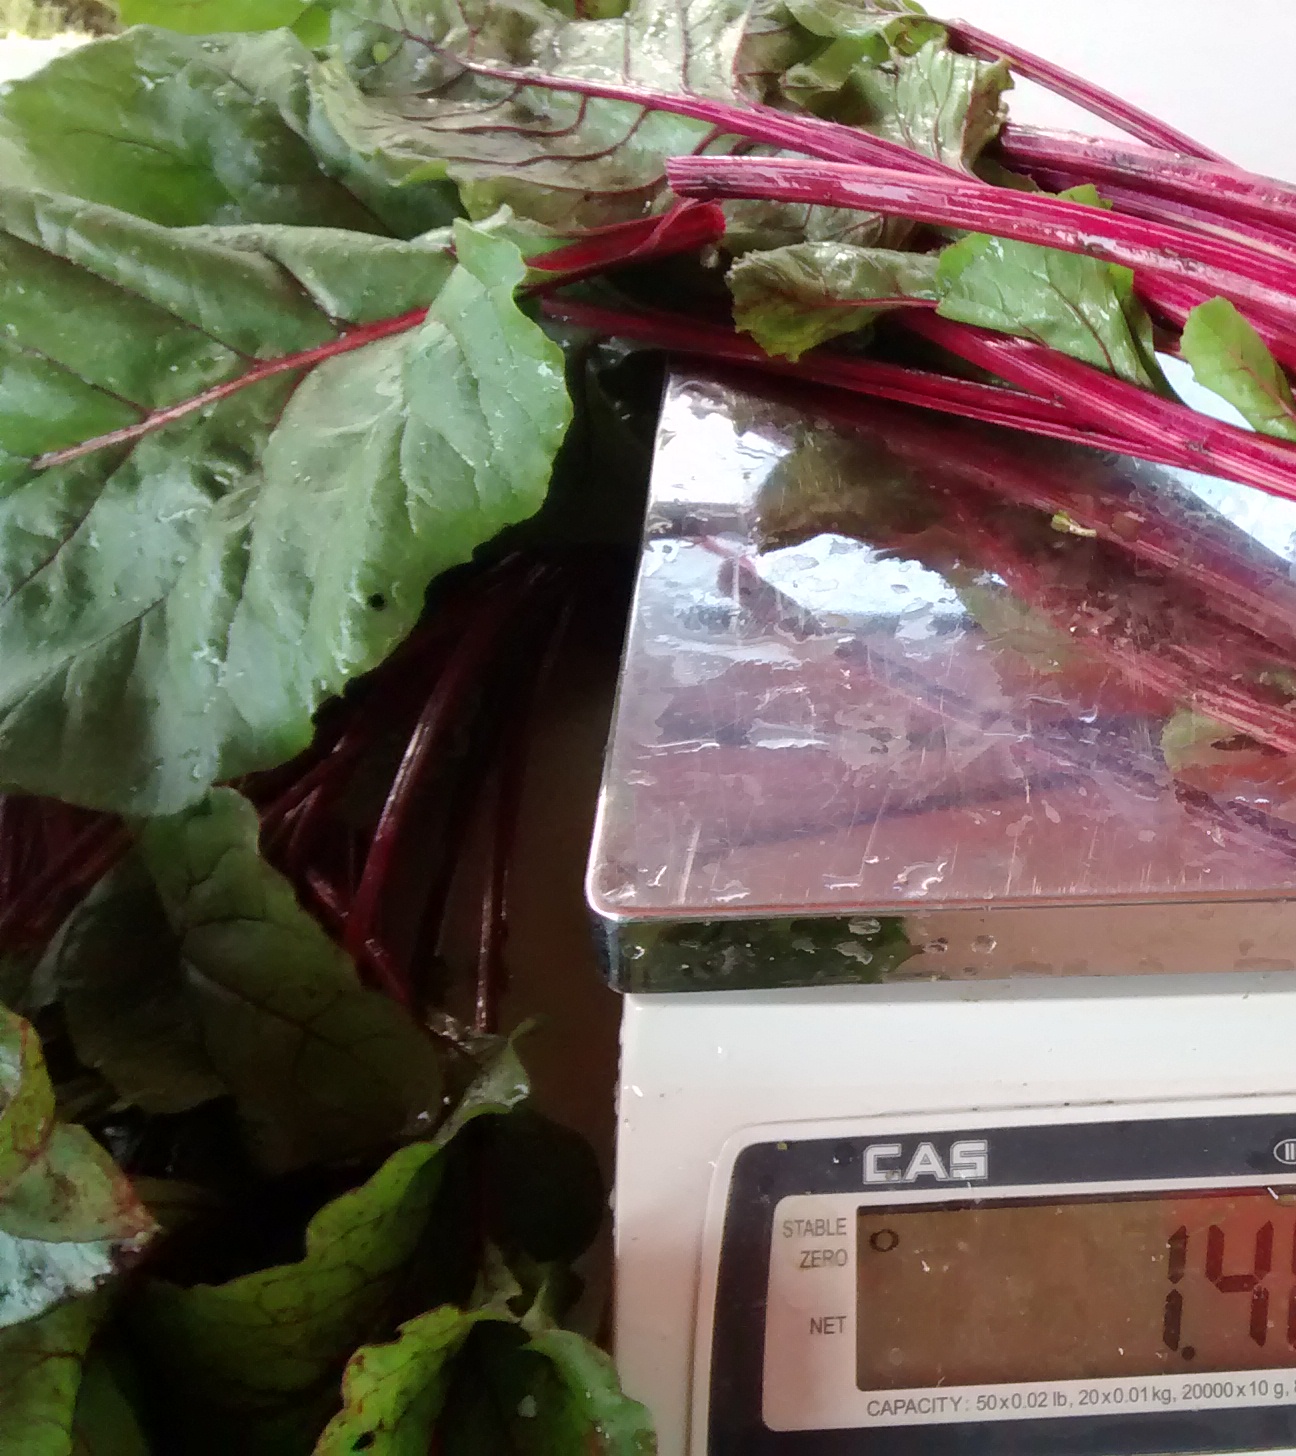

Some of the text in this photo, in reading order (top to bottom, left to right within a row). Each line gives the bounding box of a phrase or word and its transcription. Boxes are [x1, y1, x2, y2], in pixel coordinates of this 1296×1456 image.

[863, 1140, 988, 1185] CAS
[782, 1217, 847, 1238] STABLE
[800, 1248, 848, 1269] ZERO
[810, 1315, 847, 1335] NET
